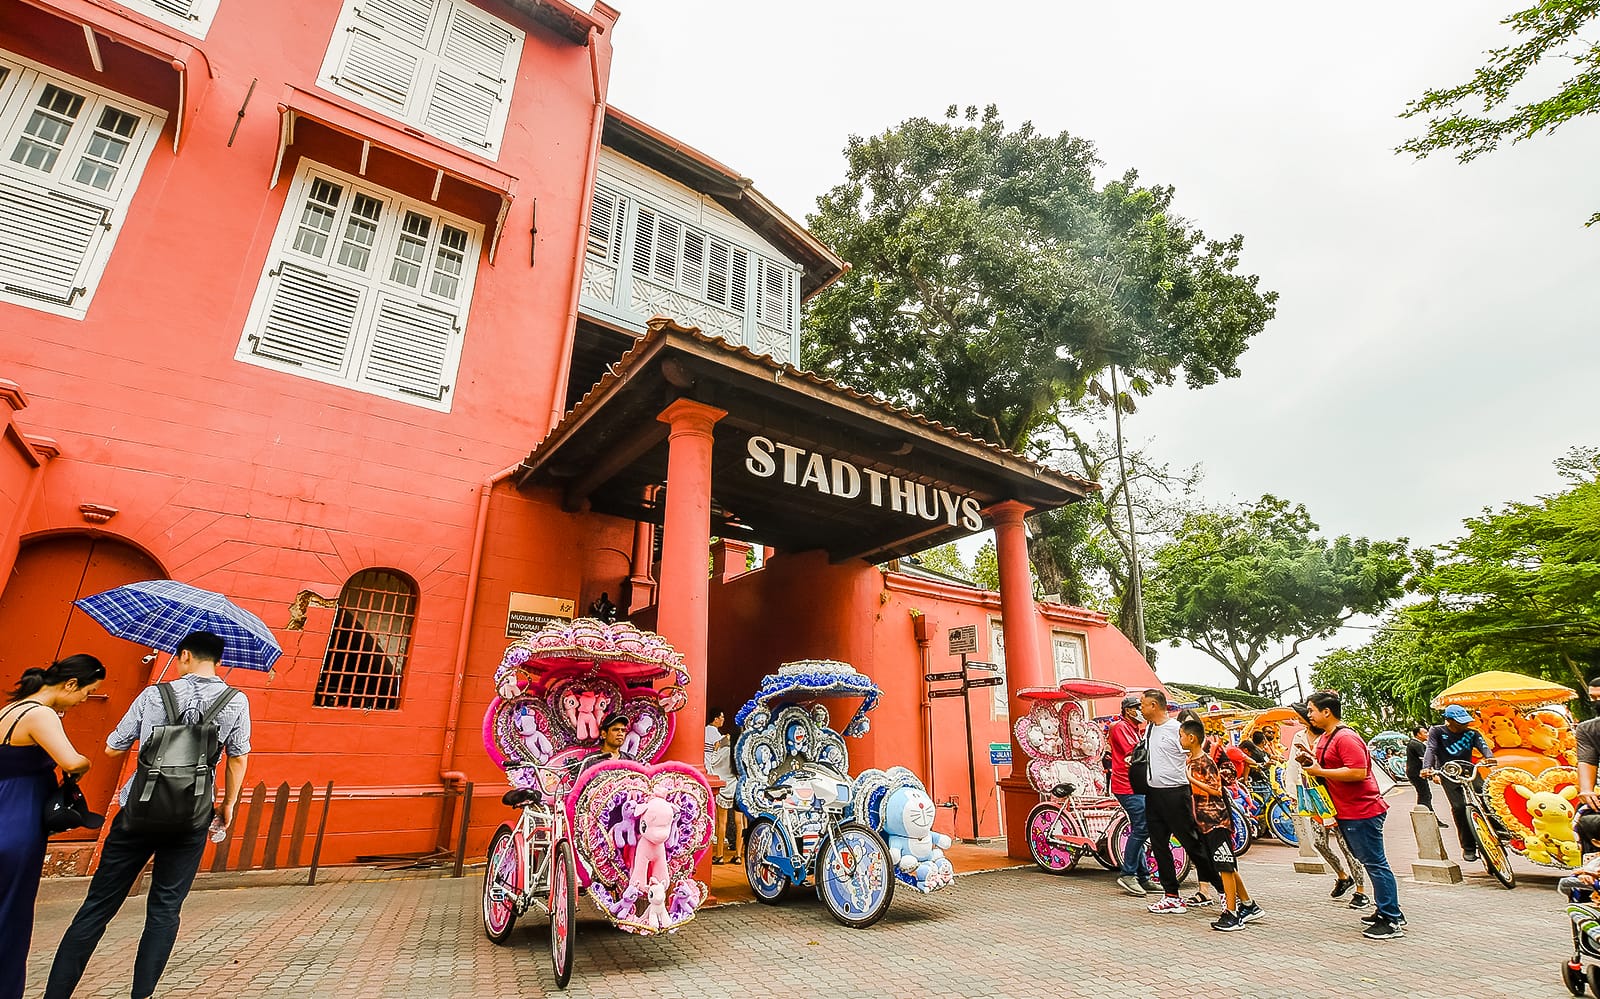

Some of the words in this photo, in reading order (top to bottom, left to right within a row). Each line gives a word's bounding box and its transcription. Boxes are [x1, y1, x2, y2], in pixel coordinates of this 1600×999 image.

[745, 436, 983, 532] STADTHUYS
[511, 614, 534, 622] MUZIUM
[510, 622, 540, 631] ETNOGRAFI
[1213, 854, 1234, 862] adida
